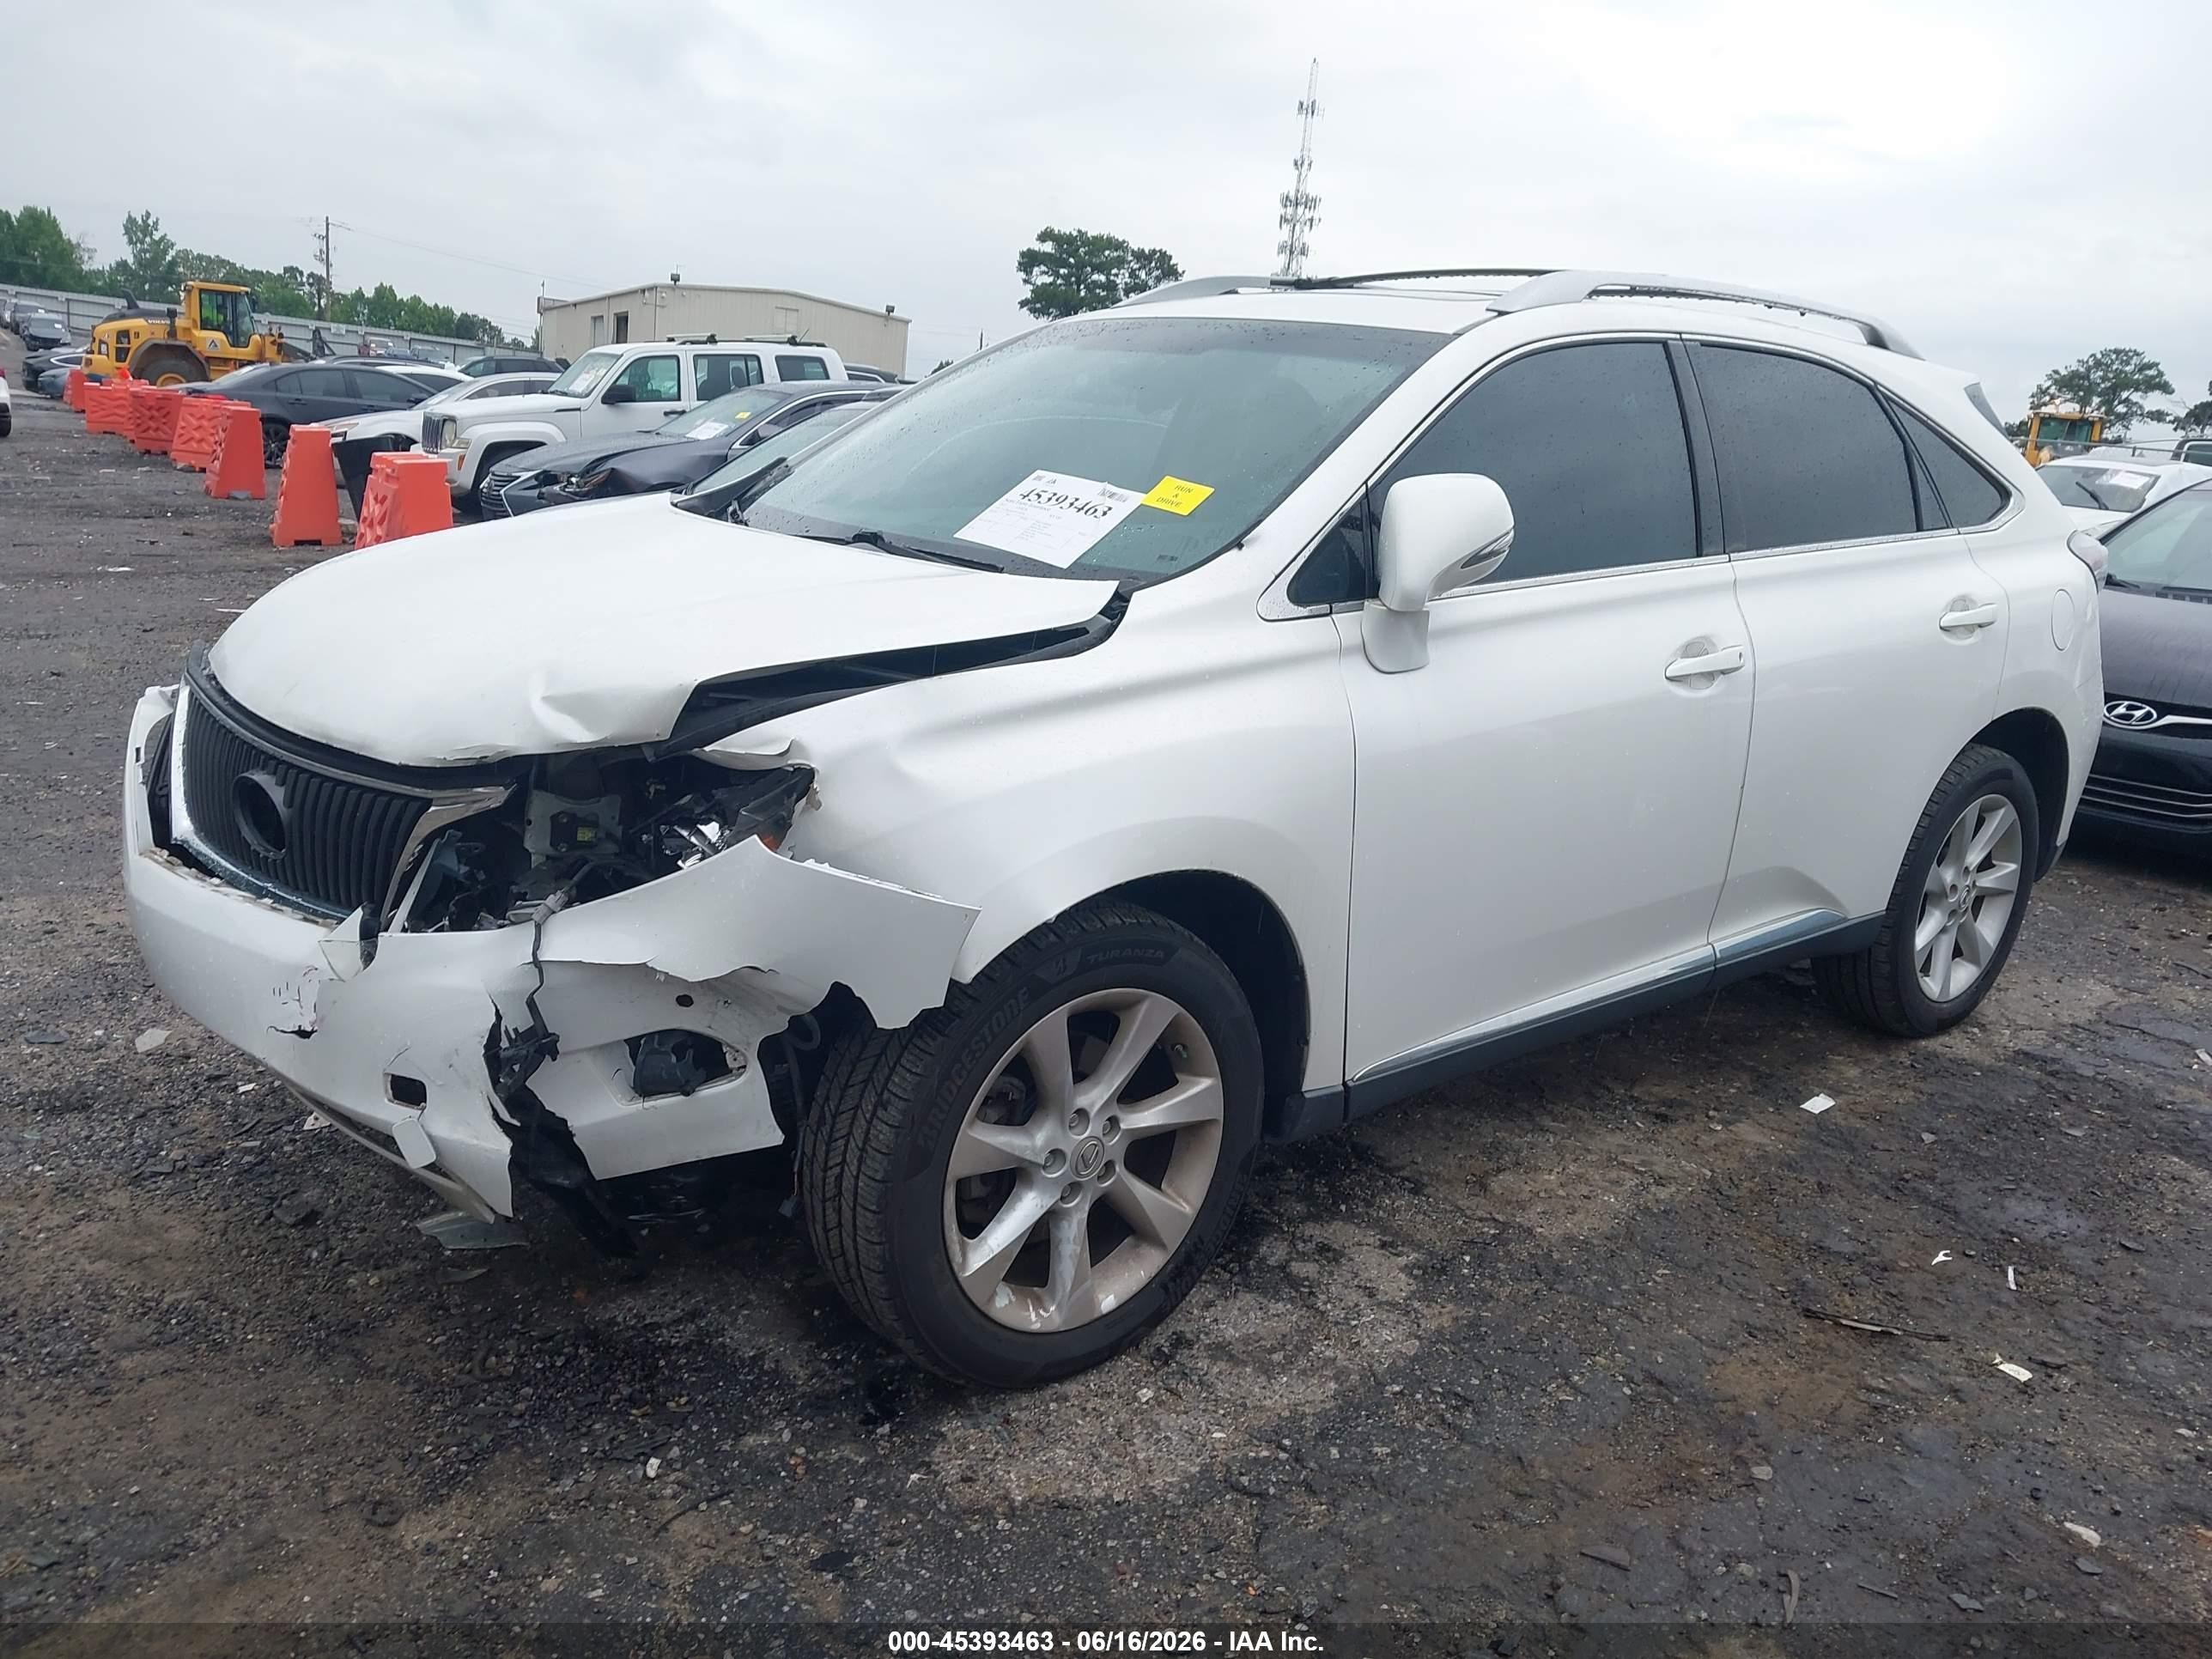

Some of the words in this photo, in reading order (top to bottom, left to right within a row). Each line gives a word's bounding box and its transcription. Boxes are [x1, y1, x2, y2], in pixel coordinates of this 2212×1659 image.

[1174, 484, 1194, 494] RUN
[1019, 487, 1114, 520] 45393463
[1156, 496, 1182, 507] DRIVE
[1086, 947, 1165, 964] TURANZA
[917, 986, 1030, 1151] BRIDGESTONE
